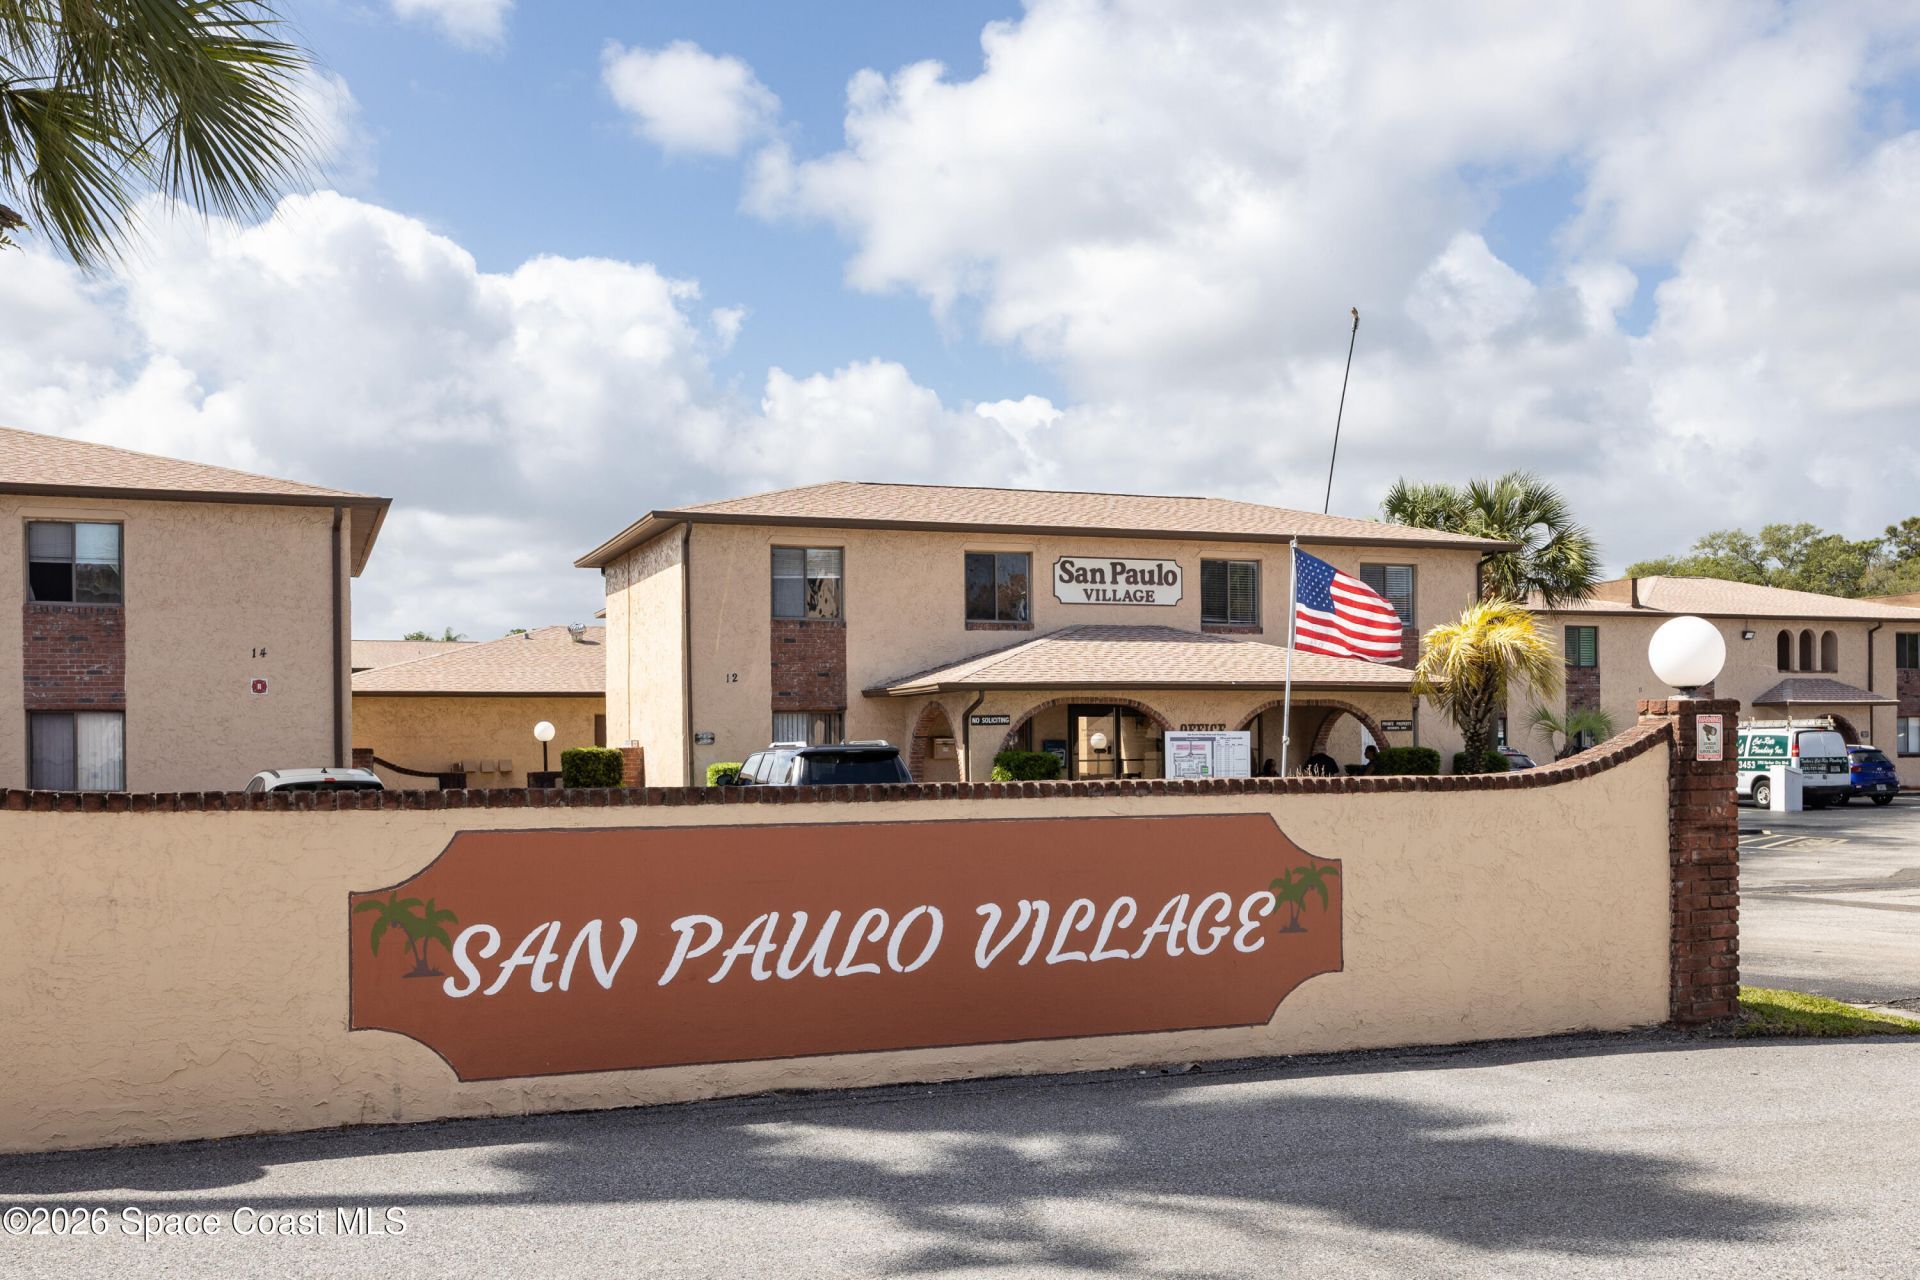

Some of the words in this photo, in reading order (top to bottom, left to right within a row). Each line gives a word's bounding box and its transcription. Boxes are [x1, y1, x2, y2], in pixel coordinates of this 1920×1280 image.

[1059, 560, 1106, 584] San
[1110, 562, 1178, 586] Paulo
[1083, 588, 1155, 603] VILLAGE
[252, 647, 267, 658] 14
[726, 672, 738, 683] 12
[1738, 761, 1755, 769] 3453
[443, 917, 638, 997] SAN
[658, 905, 943, 986] PAULO
[974, 891, 1276, 969] VILLAGE
